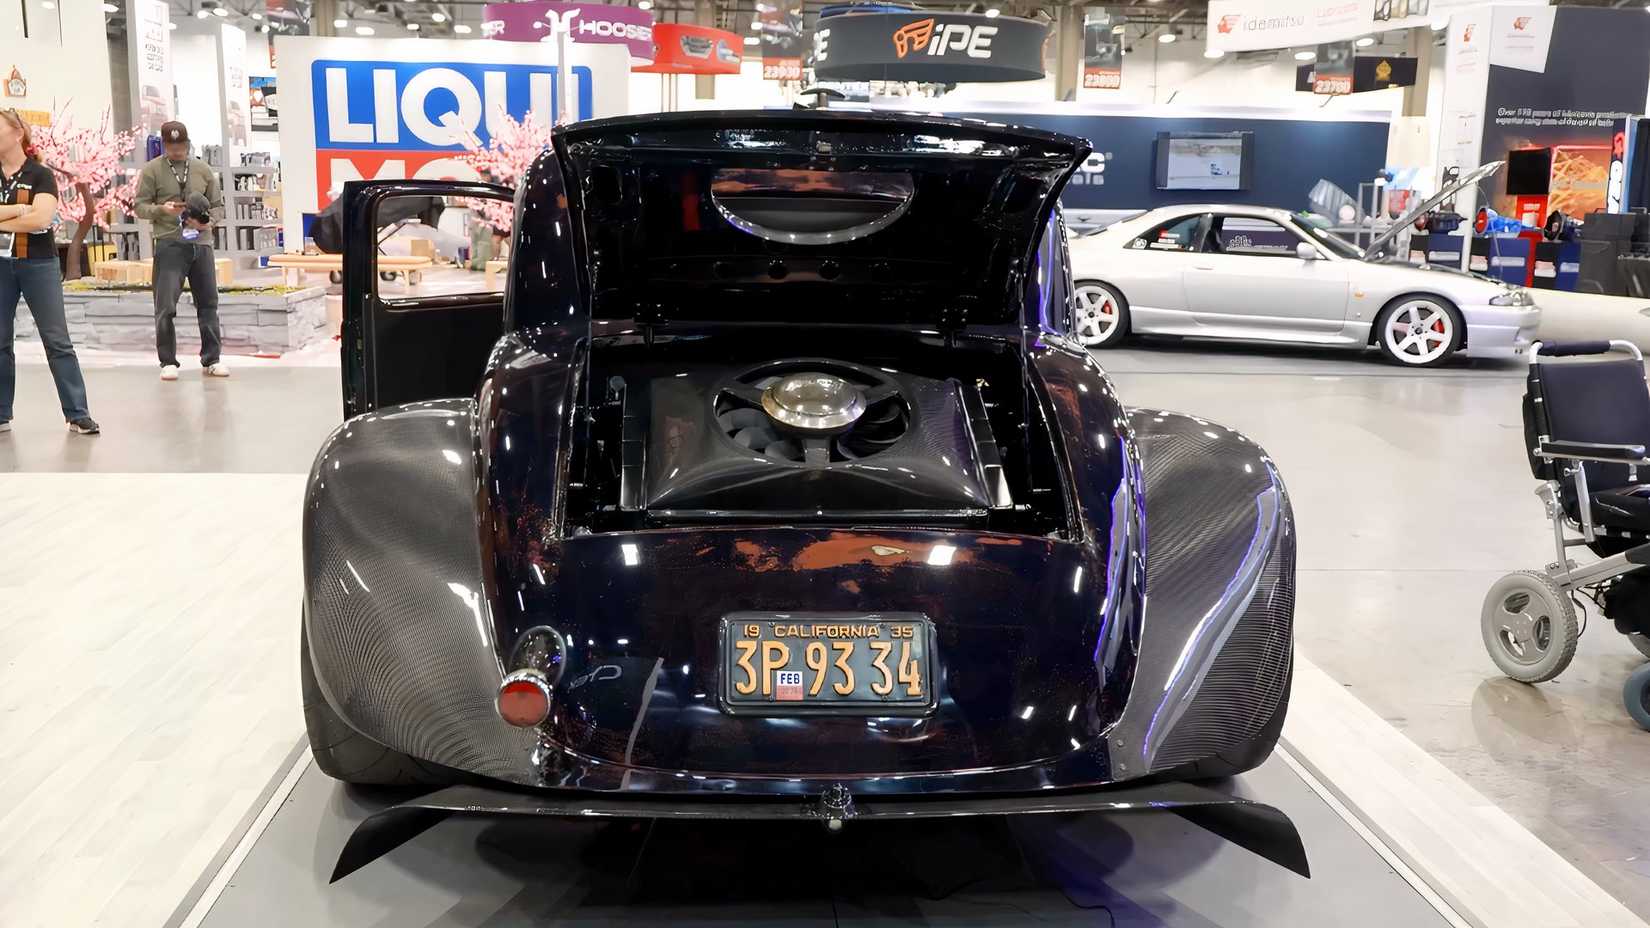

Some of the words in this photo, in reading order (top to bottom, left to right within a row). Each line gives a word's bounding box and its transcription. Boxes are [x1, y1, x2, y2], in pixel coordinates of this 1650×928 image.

[927, 24, 998, 59] iPE
[774, 624, 880, 638] CALIFORNIA
[890, 625, 913, 638] 35
[735, 640, 790, 695] 3P
[805, 641, 855, 696] 93
[869, 641, 923, 696] 34
[780, 673, 800, 684] FEB
